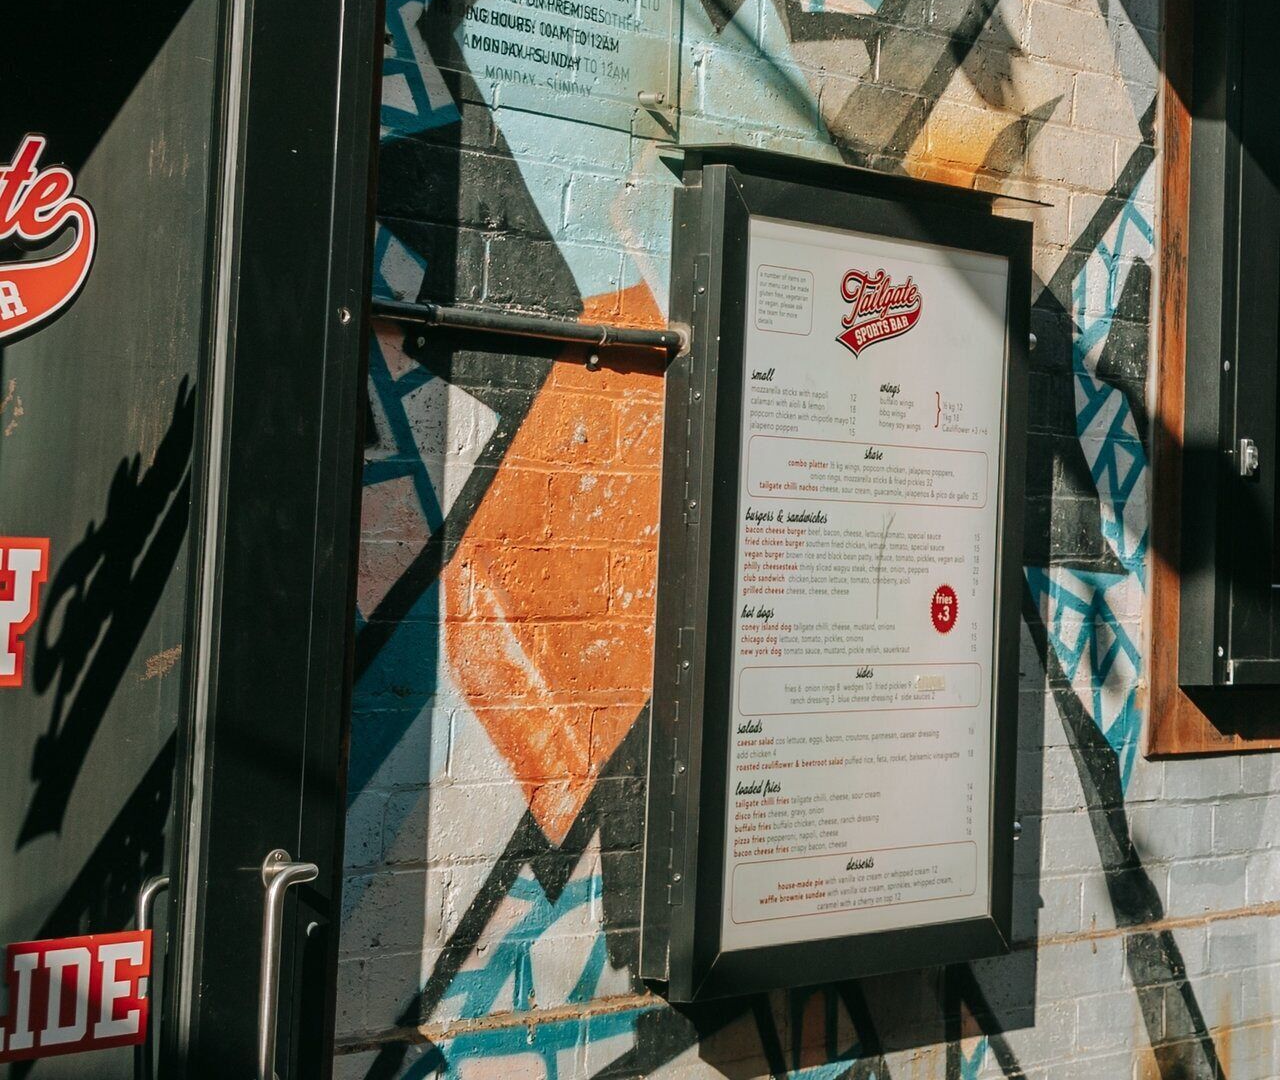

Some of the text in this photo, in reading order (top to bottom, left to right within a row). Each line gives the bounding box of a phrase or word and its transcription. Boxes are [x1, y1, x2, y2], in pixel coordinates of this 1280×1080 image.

[490, 10, 534, 34] HOURS:
[591, 34, 620, 54] 12AM
[534, 48, 580, 71] SUNDAY
[841, 269, 916, 325] Tailgate
[854, 314, 908, 346] SPORTS BAR
[751, 368, 775, 381] small
[751, 386, 780, 394] mozzarella
[783, 388, 797, 396] sticks
[812, 391, 828, 399] napoli
[880, 383, 900, 397] wings
[802, 401, 806, 409] &
[808, 401, 825, 410] lemon
[900, 400, 914, 409] wings
[750, 409, 774, 419] popcorn
[776, 410, 796, 419] chicken
[798, 412, 809, 420] with
[811, 414, 833, 425] chipotle
[892, 410, 906, 418] wings
[776, 423, 798, 432] poppers
[907, 423, 921, 432] wings
[864, 447, 883, 460] share
[809, 460, 829, 470] platter
[760, 481, 818, 492] tailgate chilli nachos
[746, 507, 827, 525] burgers & sandwiches
[746, 525, 806, 537] bacon cheese burger
[745, 537, 760, 546] fried
[762, 538, 784, 546] chicken
[785, 540, 805, 549] burger
[745, 551, 763, 559] vegan
[765, 550, 784, 560] burger
[816, 551, 826, 559] and
[828, 552, 842, 560] black
[744, 562, 760, 571] philly
[763, 562, 798, 570] cheesesteak
[743, 574, 785, 582] club sandwich
[743, 586, 763, 596] grilled
[936, 593, 953, 604] fries
[741, 604, 774, 623] hot dogs
[938, 606, 950, 621] +3
[742, 623, 759, 632] coney
[781, 623, 792, 633] dog
[741, 635, 777, 645] chicago dog
[755, 647, 768, 657] york
[771, 647, 782, 657] dog
[856, 664, 874, 678] sides
[737, 720, 763, 734] salads
[737, 737, 774, 747] caesar salad
[737, 762, 760, 771] roasted
[762, 760, 793, 770] cauliflower
[802, 759, 827, 767] beetroot
[829, 757, 843, 766] salad
[736, 779, 781, 797] loaded fries
[736, 797, 789, 809] tailgate chilli fries
[753, 810, 766, 819] fries
[735, 822, 771, 833] buffalo fries
[734, 835, 765, 845] pizza fries
[734, 846, 789, 858] bacon cheese fries
[846, 856, 874, 870] desserts
[778, 877, 824, 890] house-made pie
[759, 890, 825, 904] waffle brownie sundae
